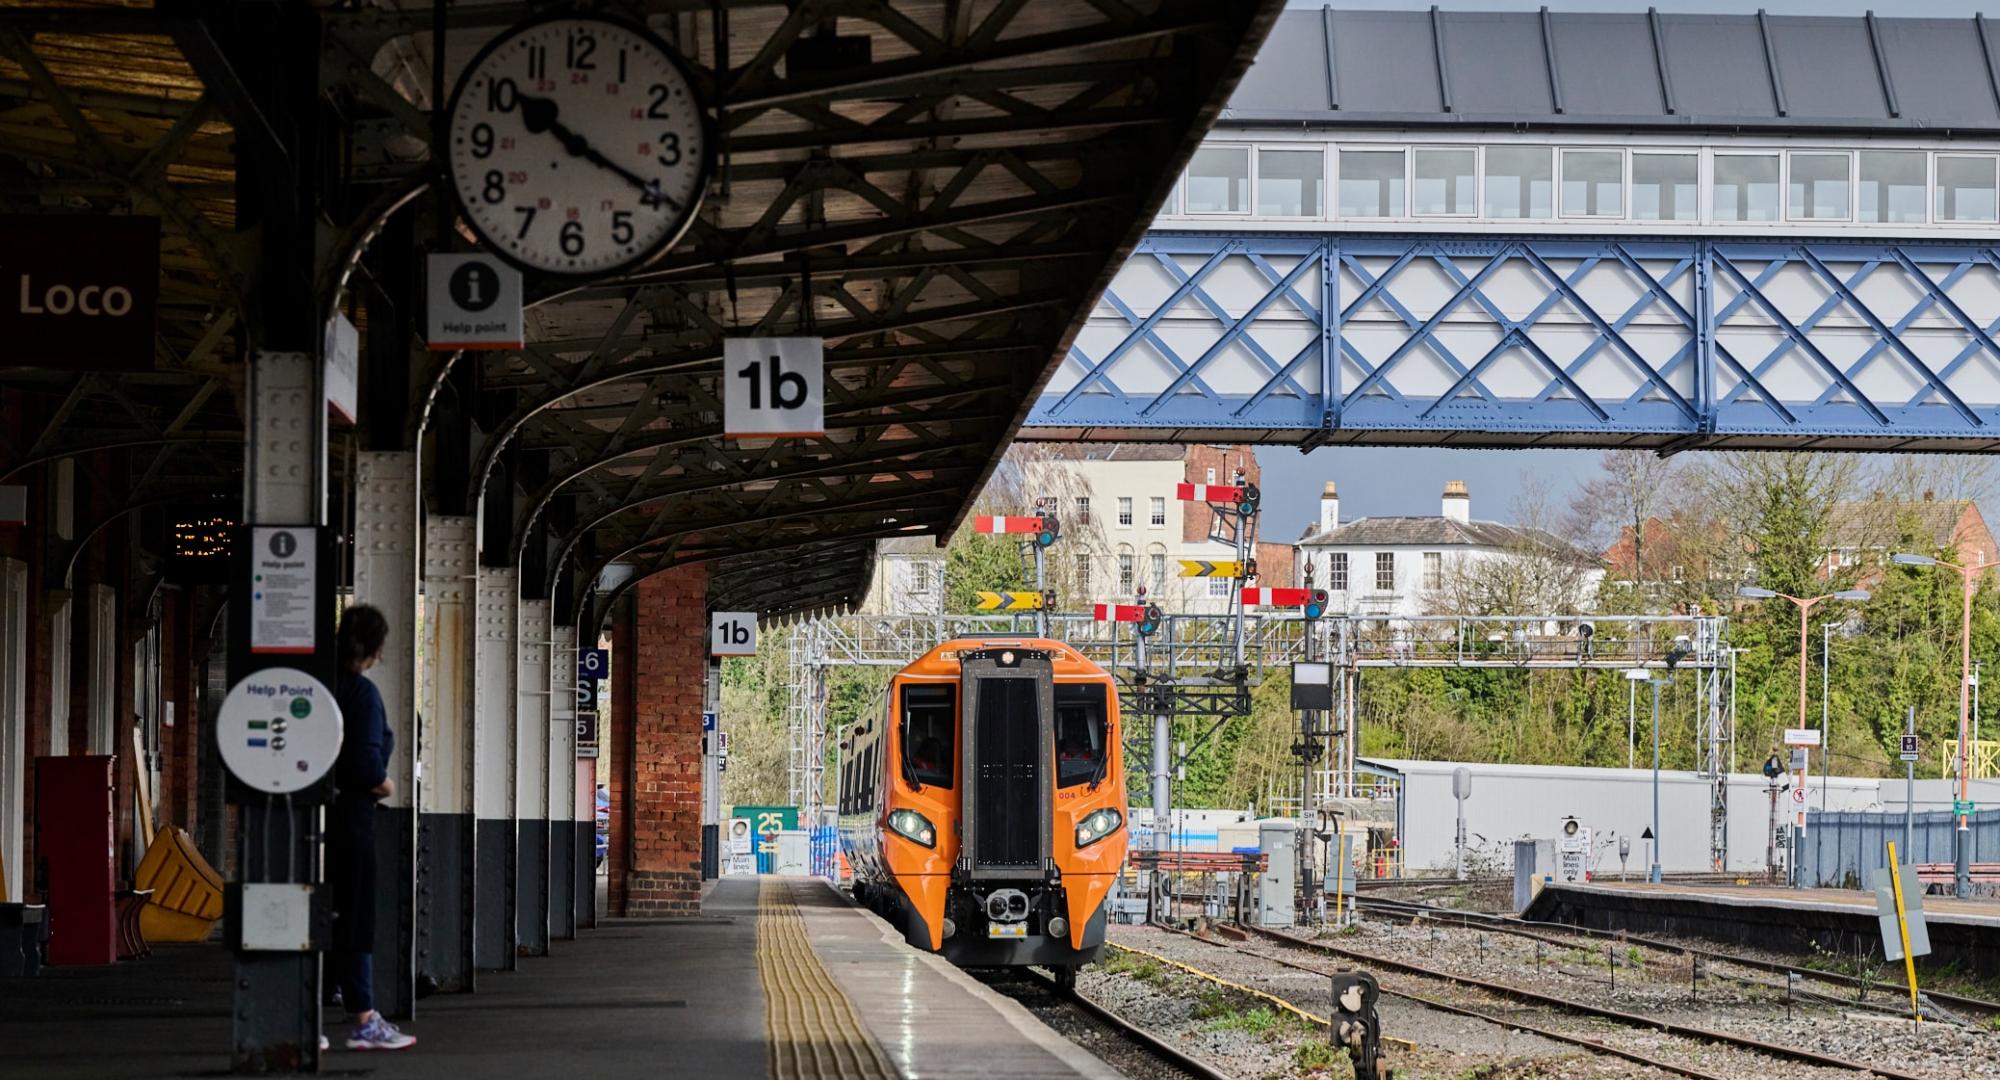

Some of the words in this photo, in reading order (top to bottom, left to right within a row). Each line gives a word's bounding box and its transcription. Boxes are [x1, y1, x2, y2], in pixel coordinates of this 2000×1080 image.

[529, 46, 545, 79] 11
[567, 35, 596, 69] 12
[619, 49, 626, 82] 1
[488, 78, 517, 112] 10
[648, 84, 669, 119] 2
[471, 124, 494, 158] 9
[658, 133, 681, 166] 3
[483, 170, 505, 203] 8
[515, 207, 536, 239] 7
[560, 221, 584, 256] 6
[612, 211, 633, 244] 5
[19, 272, 133, 317] Loco
[443, 321, 472, 335] Help
[475, 321, 507, 335] point
[738, 355, 807, 410] 1b
[261, 561, 281, 569] Help
[283, 561, 305, 570] point
[718, 619, 749, 645] 1b
[247, 684, 276, 697] Help
[280, 684, 313, 697] Point
[757, 812, 784, 835] 25
[1563, 869, 1579, 877] only
